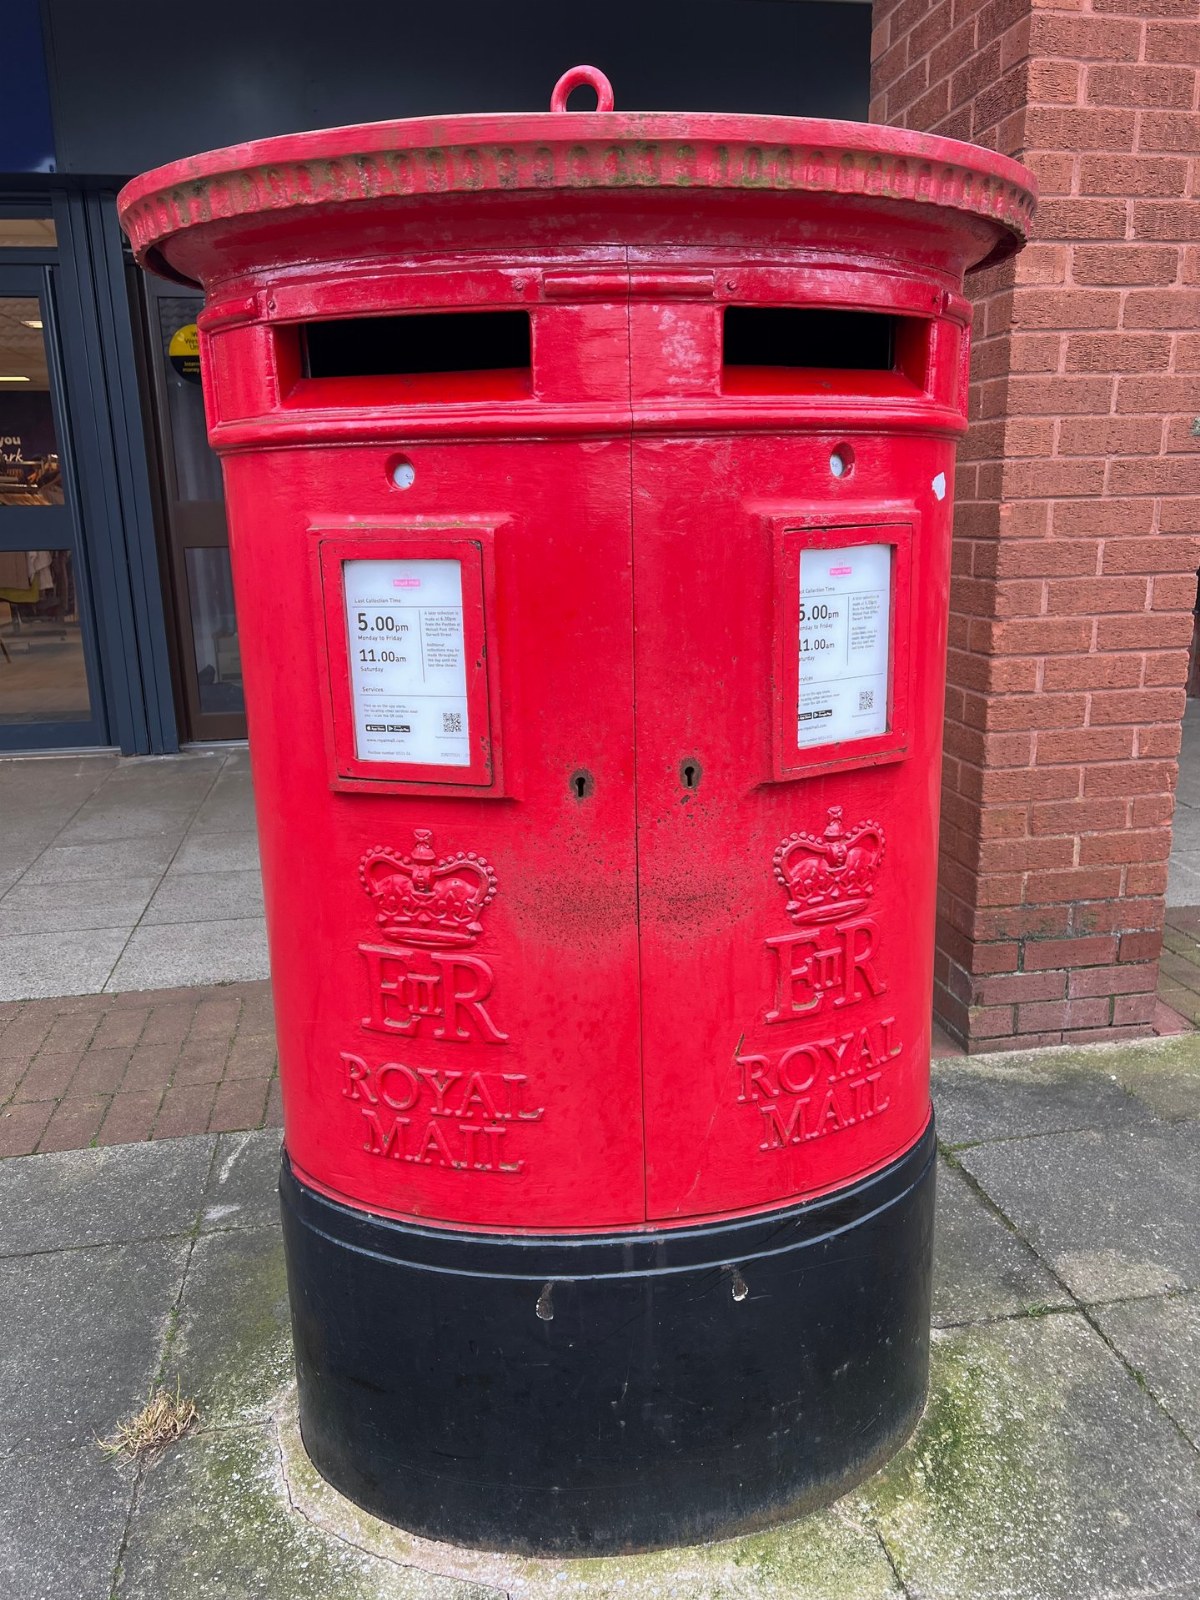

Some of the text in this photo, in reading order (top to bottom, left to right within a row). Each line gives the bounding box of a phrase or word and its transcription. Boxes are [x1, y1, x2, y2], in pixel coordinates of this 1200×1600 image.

[357, 612, 409, 633] 5.00pm
[359, 648, 407, 663] 11.00am
[339, 1051, 545, 1122] ROYAL
[736, 1016, 903, 1104] ROYAL
[361, 1107, 526, 1174] MAIL
[759, 1071, 890, 1152] MAIL
